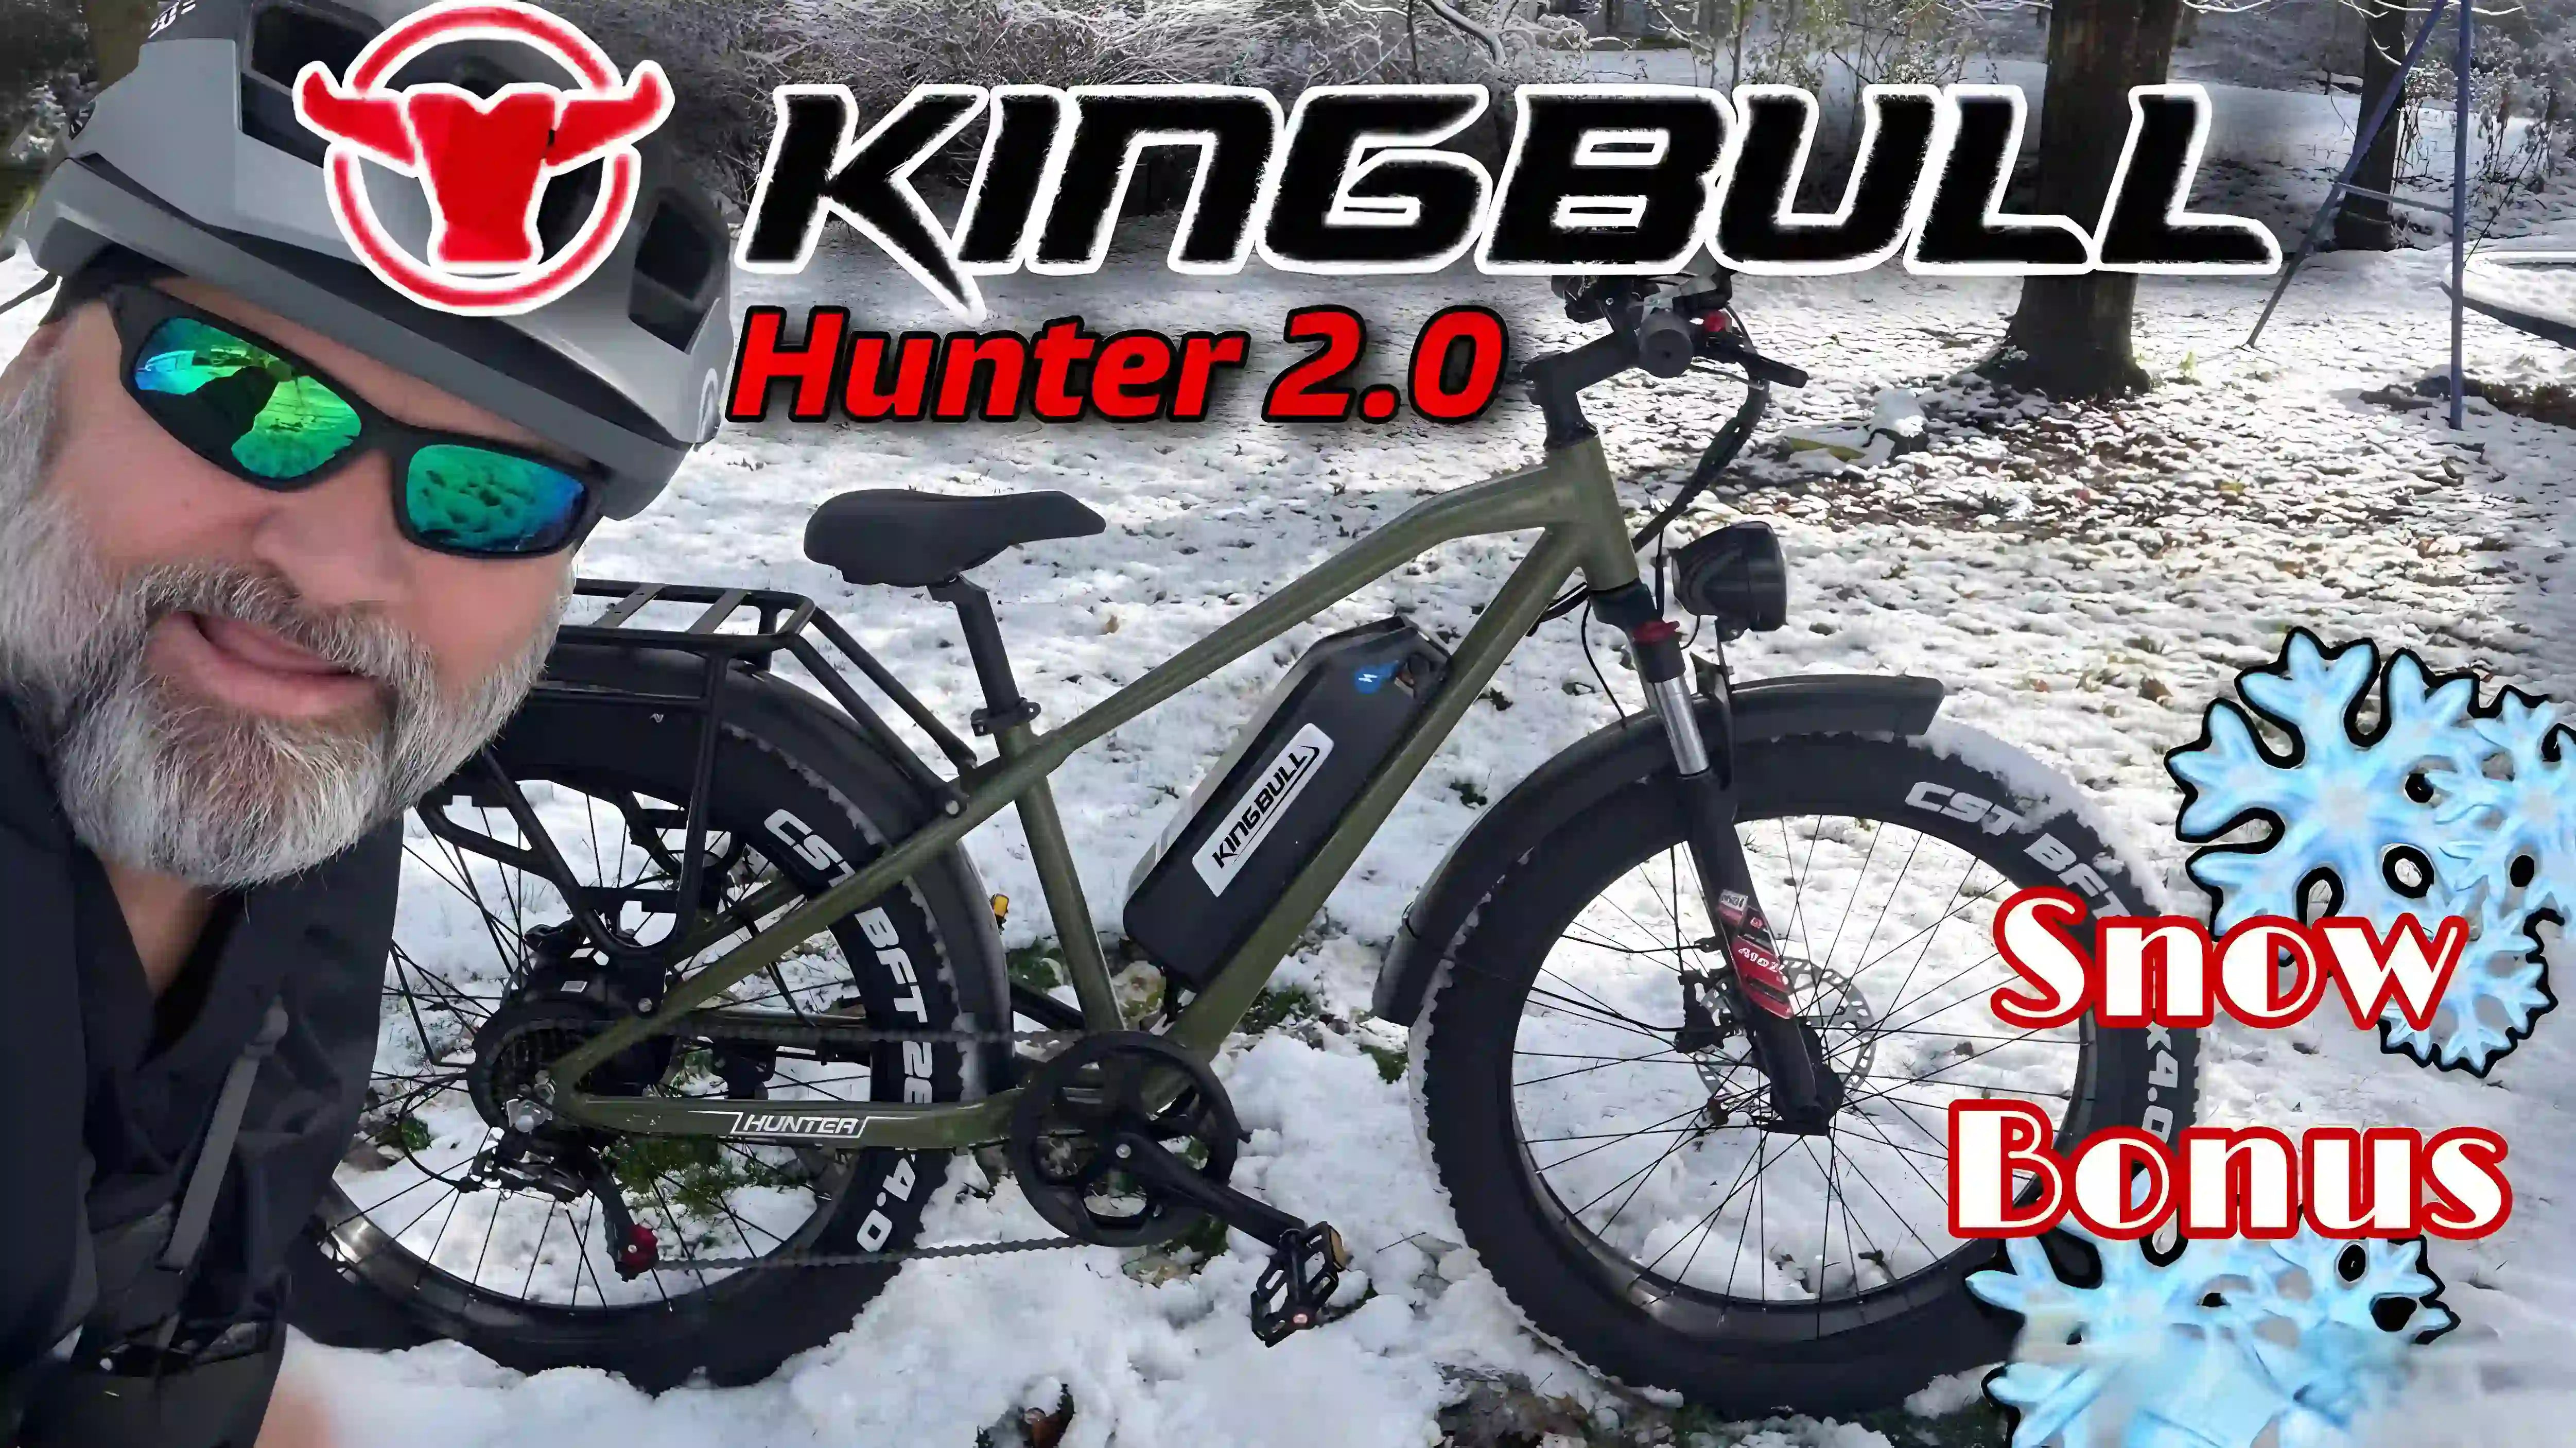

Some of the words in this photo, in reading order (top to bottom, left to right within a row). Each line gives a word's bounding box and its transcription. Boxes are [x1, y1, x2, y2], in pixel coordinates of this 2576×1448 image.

[1212, 752, 1308, 869] KINGBULL
[855, 906, 929, 1023] BFT
[743, 1114, 859, 1134] HUNTER
